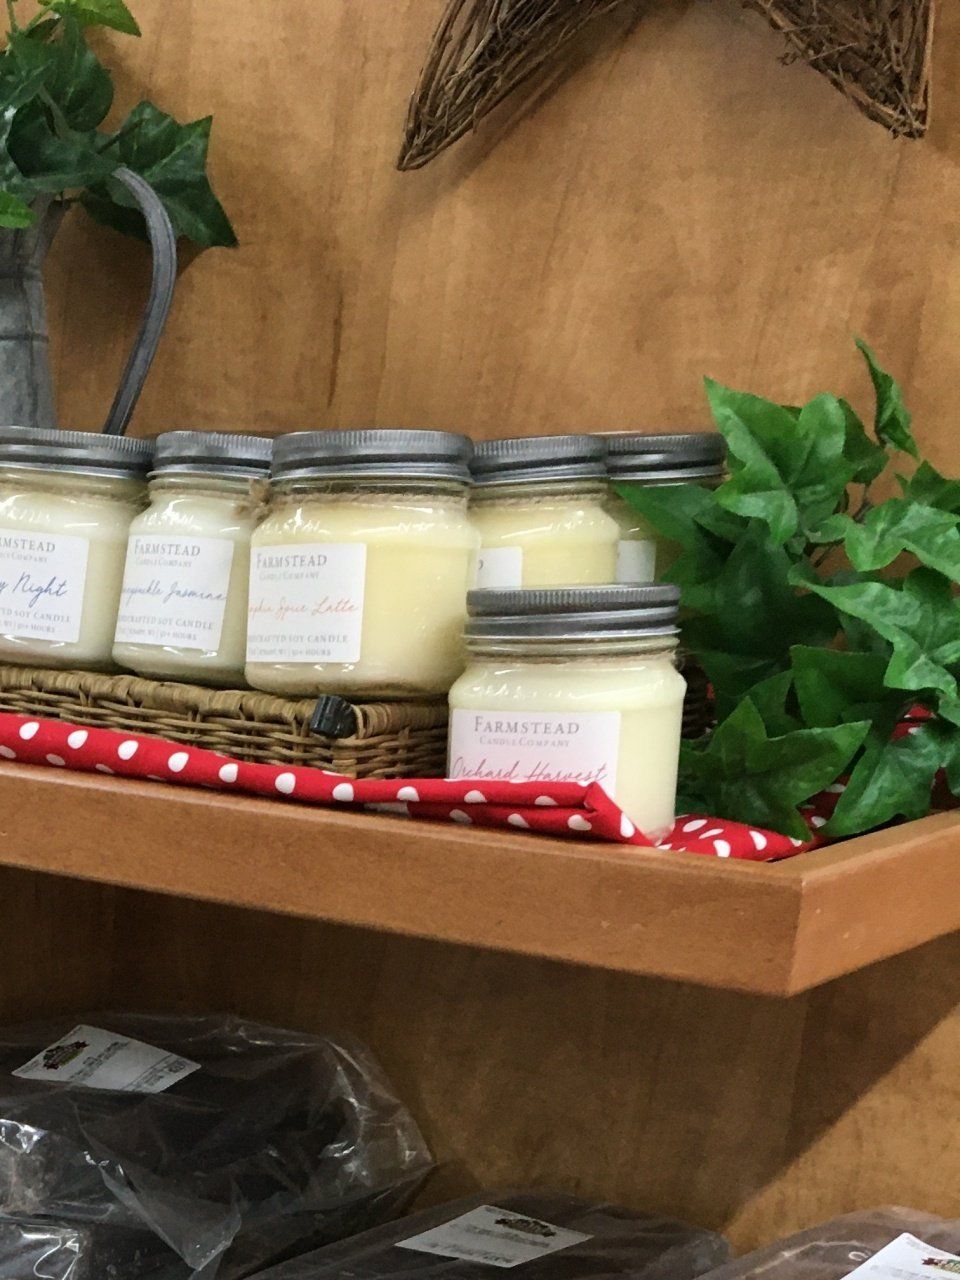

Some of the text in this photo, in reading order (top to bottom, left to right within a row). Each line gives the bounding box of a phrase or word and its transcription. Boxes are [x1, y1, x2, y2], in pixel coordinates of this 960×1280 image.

[134, 539, 201, 557] FARMSTEAD
[257, 553, 328, 569] FARMSTEAD
[12, 571, 68, 608] Night
[311, 595, 359, 616] Latte
[33, 611, 70, 624] CANDLE
[175, 618, 214, 630] CANDLE
[307, 634, 348, 643] CANDLE
[474, 715, 580, 735] FARMSTEAD
[479, 736, 571, 748] CANDLE COMPANY
[451, 756, 610, 782] Orchard Harvest
